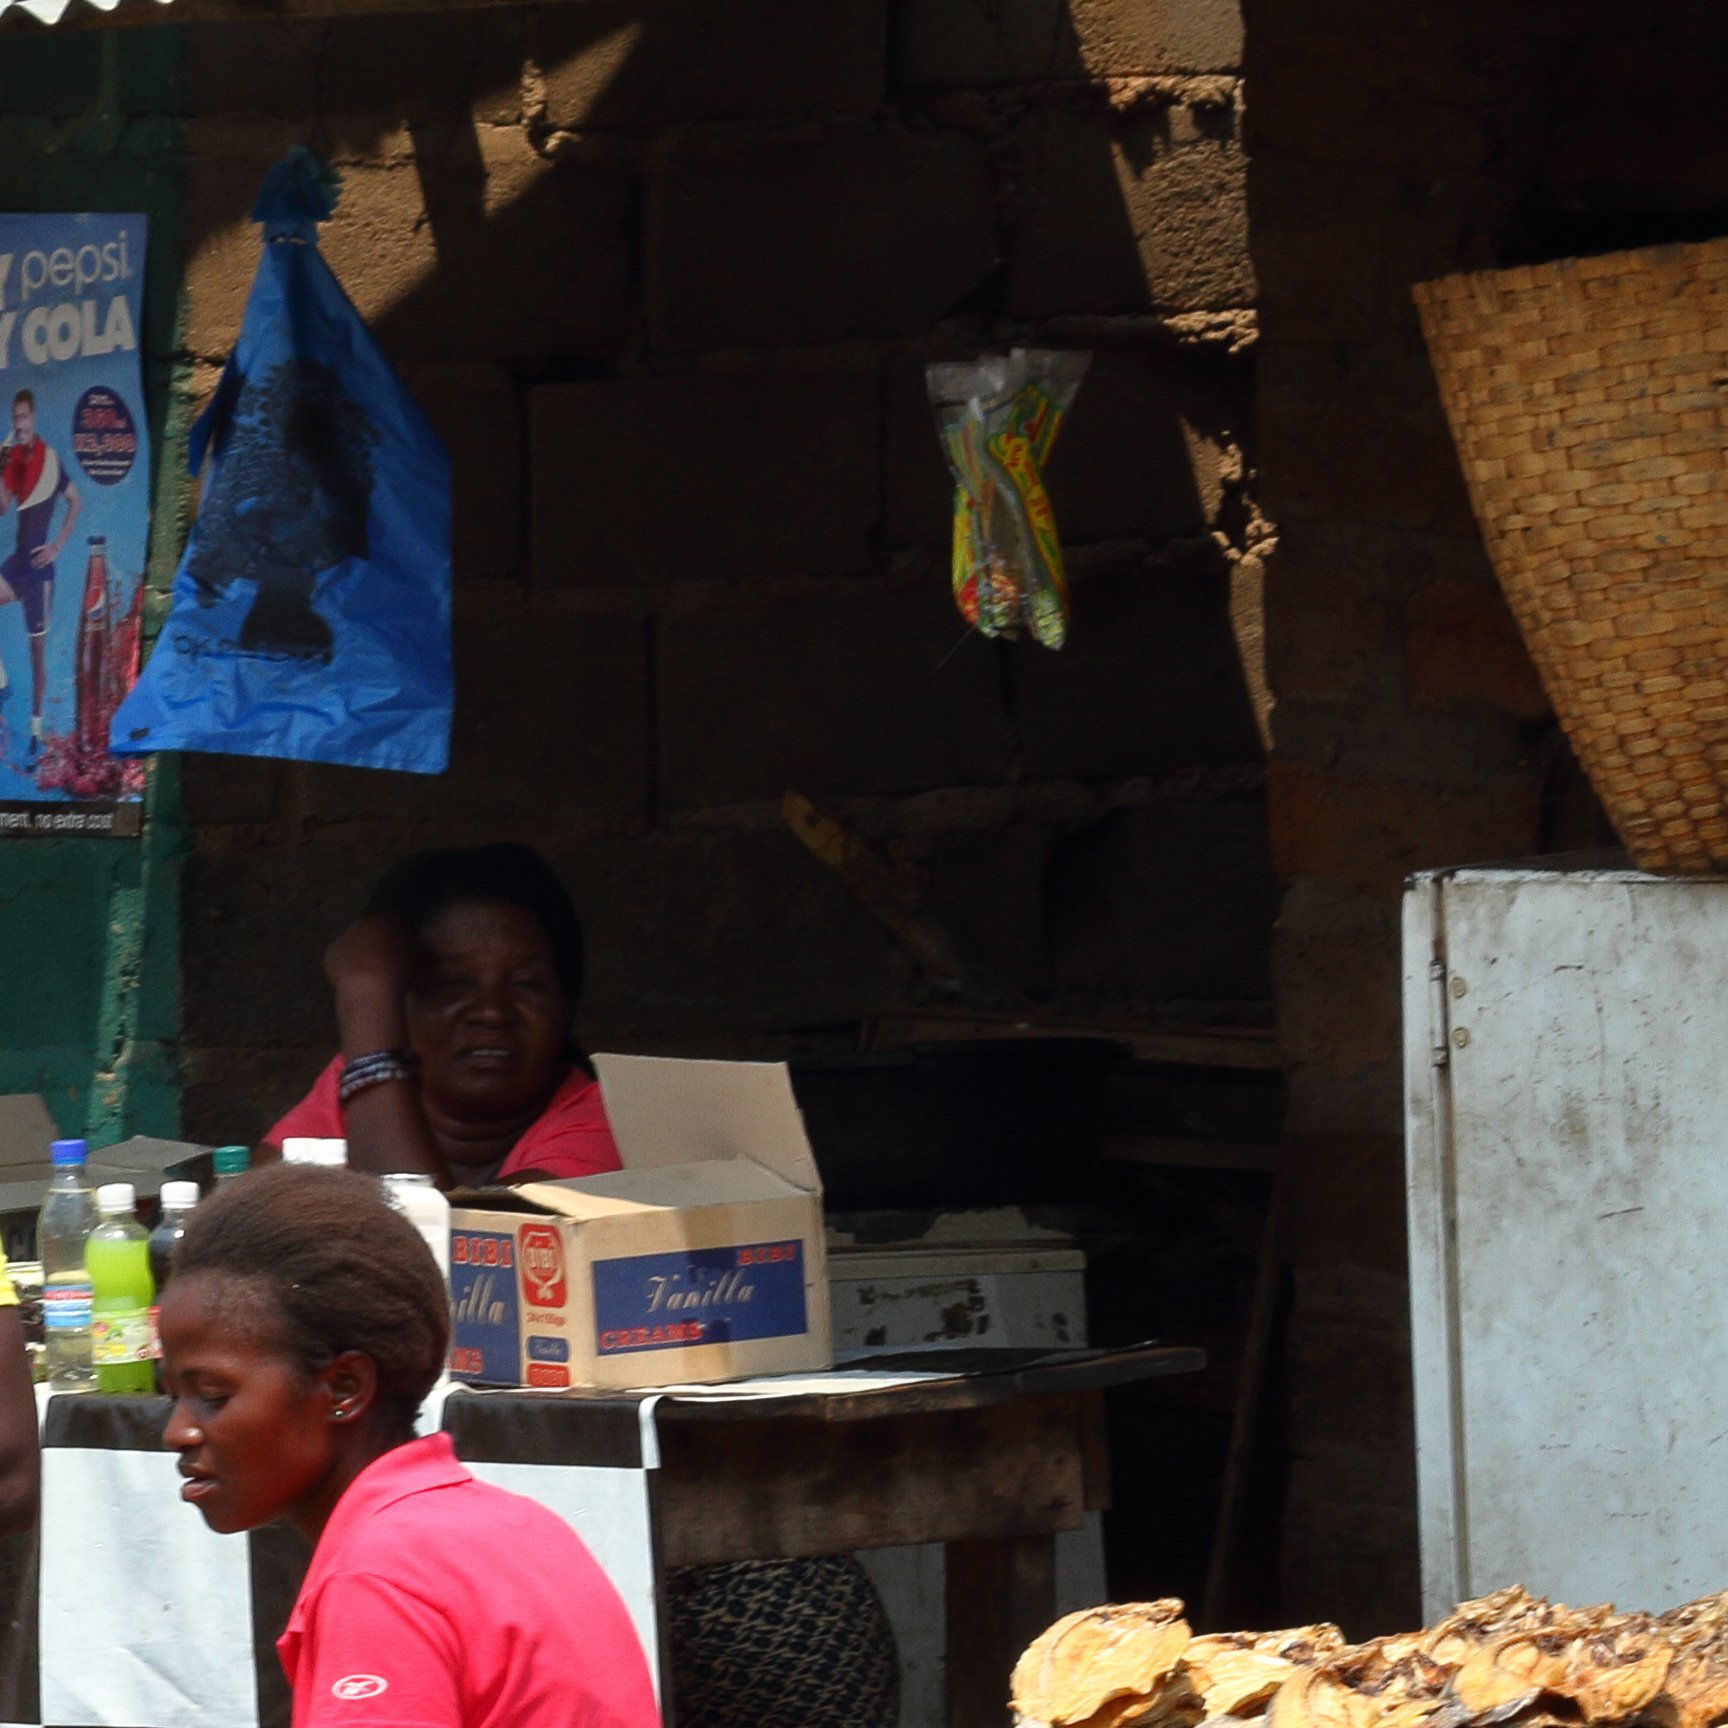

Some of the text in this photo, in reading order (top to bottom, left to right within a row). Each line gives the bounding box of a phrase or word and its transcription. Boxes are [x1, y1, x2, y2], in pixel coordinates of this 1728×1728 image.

[21, 230, 134, 301] pepsi
[22, 295, 137, 365] COLA
[452, 1236, 513, 1269] BIBI
[736, 1244, 797, 1266] BIBI
[645, 1269, 756, 1314] Vanilla
[599, 1320, 705, 1350] CREAMS
